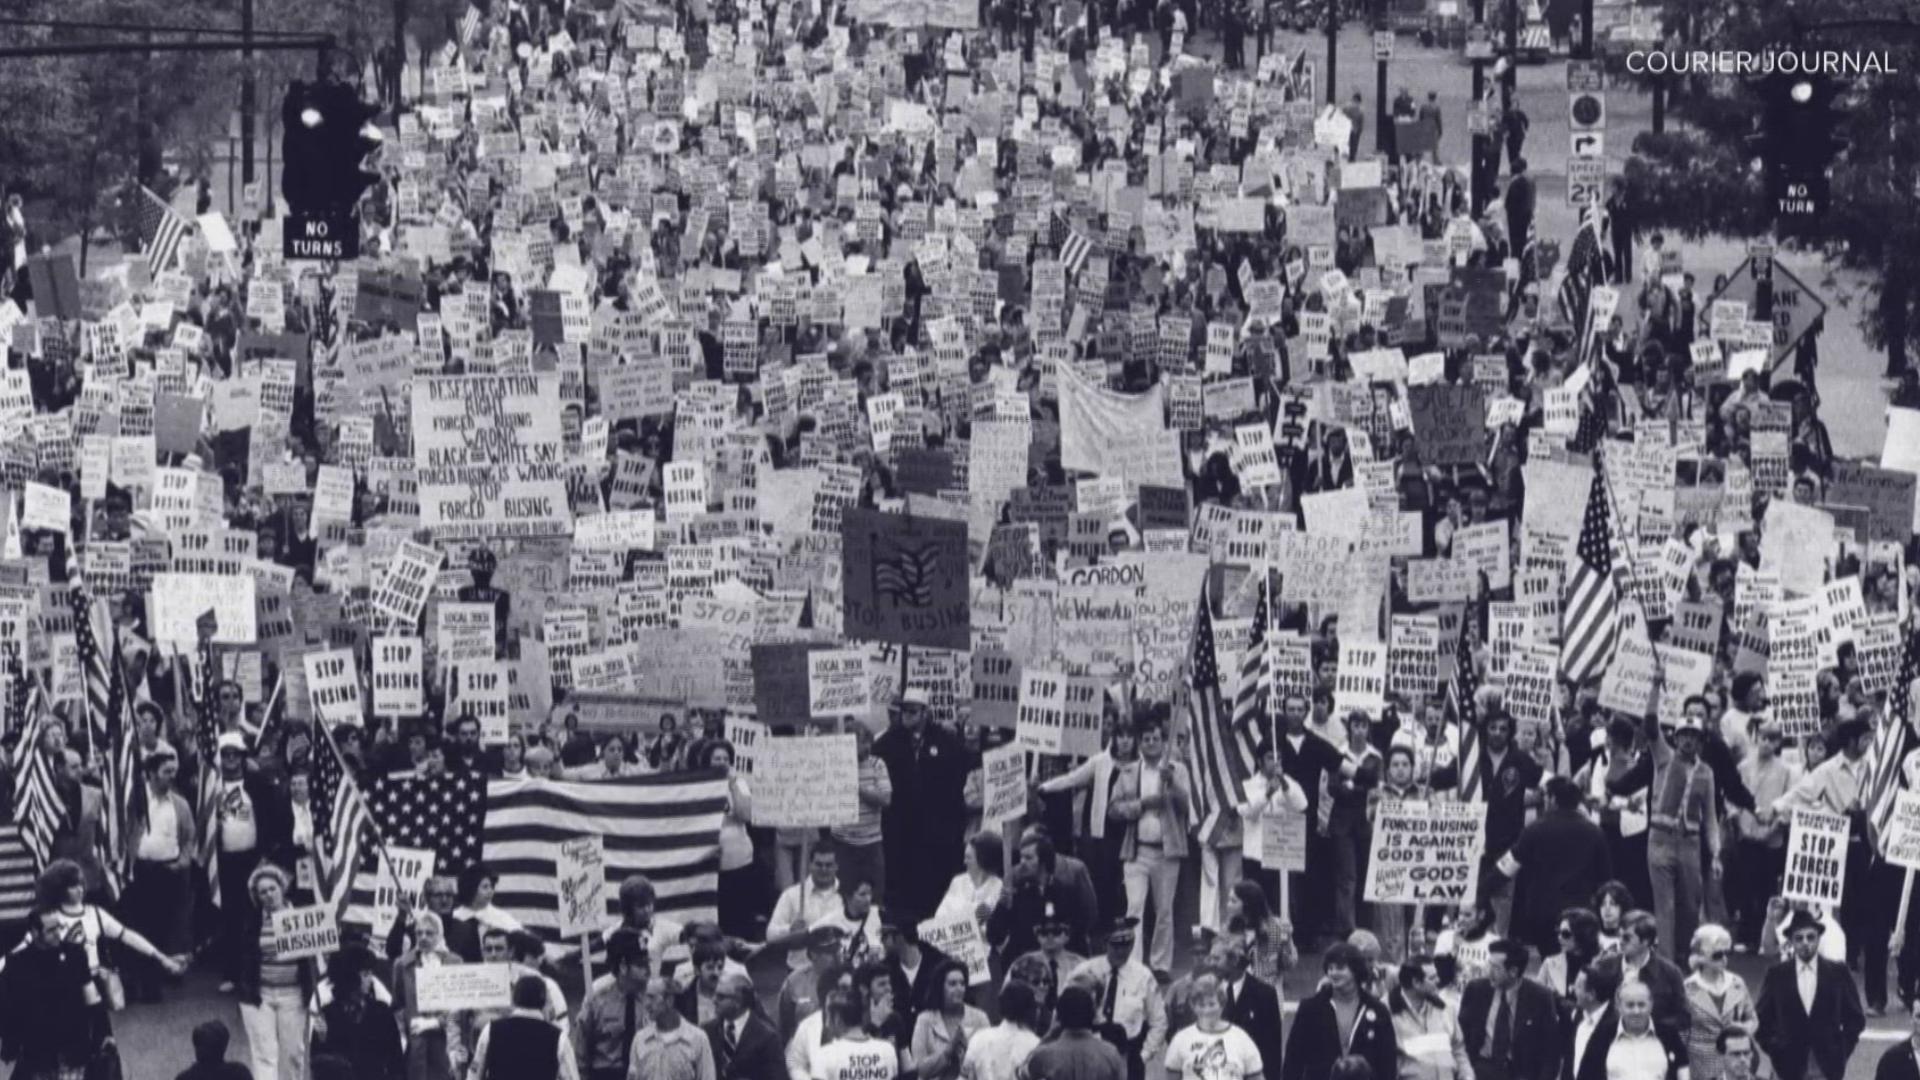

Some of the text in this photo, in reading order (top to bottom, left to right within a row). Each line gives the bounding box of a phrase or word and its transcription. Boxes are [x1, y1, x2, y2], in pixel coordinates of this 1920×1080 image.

[1571, 164, 1601, 172] SPEED
[1571, 184, 1600, 202] 25
[1787, 184, 1808, 197] NO
[1778, 200, 1815, 214] TURN
[305, 221, 329, 237] NO
[291, 239, 343, 256] TURNS
[428, 376, 539, 400] DESEGREGATION
[874, 398, 897, 414] STOP
[432, 411, 532, 431] FORCED BUSING
[461, 427, 519, 449] WRONG
[1242, 430, 1263, 446] STOP
[429, 441, 558, 468] BLACK WHITE SAY
[418, 462, 563, 487] FORCED BUSING IS WRONG
[622, 459, 647, 476] STOP
[670, 467, 696, 483] STOP
[163, 474, 189, 490] STOP
[613, 478, 646, 496] BUSING
[470, 481, 502, 501] STOP
[666, 489, 703, 505] BUSING
[154, 495, 192, 510] BUSING
[438, 496, 553, 521] FORCED BUSING
[731, 495, 757, 511] STOP
[811, 506, 842, 518] FORC
[165, 514, 190, 530] STOP
[1077, 518, 1101, 534] STOP
[1237, 518, 1263, 535] STOP
[181, 533, 209, 550] STOP
[223, 536, 250, 553] STOP
[1070, 542, 1108, 557] BUSING
[174, 557, 215, 573] BUSING
[398, 559, 428, 582] STOP
[671, 559, 696, 570] LOCAL
[1526, 557, 1567, 570] OPPOSE
[669, 575, 714, 588] AGAINST
[1071, 561, 1145, 587] GORDON
[386, 573, 425, 601] FORCED
[1523, 577, 1549, 595] STOP
[377, 588, 420, 619] BUSING
[1826, 584, 1852, 606] STOP
[621, 611, 668, 629] OPPOSE
[1683, 610, 1713, 631] STOP
[1832, 606, 1864, 631] USING
[1498, 621, 1525, 639] STOP
[548, 642, 589, 659] PPOSE
[1771, 636, 1814, 653] OPPOSE
[382, 645, 412, 662] STOP
[1346, 649, 1377, 667] STOP
[1391, 649, 1438, 662] OPPOSE
[314, 658, 346, 679] STOP
[982, 657, 1013, 676] STOP
[1391, 663, 1438, 677] FORCED
[375, 672, 420, 690] BUSING
[467, 673, 499, 691] STOP
[1274, 668, 1312, 683] PPOSE
[1506, 673, 1552, 693] OPPOSE
[973, 683, 1019, 703] BUSING
[1030, 679, 1058, 699] STOP
[1275, 684, 1313, 698] ORCED
[1338, 674, 1382, 695] BUSING
[1392, 678, 1438, 691] BUSING
[311, 684, 357, 706] BUSING
[1065, 685, 1095, 703] STOP
[1504, 690, 1552, 707] FORCED
[1771, 691, 1818, 707] OPPOSE
[461, 700, 507, 718] BUSING
[1019, 704, 1062, 729] BUSING
[1773, 706, 1819, 722] FORCED
[732, 726, 756, 746] STOP
[1784, 720, 1820, 736] USING
[1381, 817, 1479, 833] FORCED BUSING
[1386, 834, 1476, 848] IS AGAINST
[1801, 832, 1836, 857] STOP
[1377, 849, 1468, 863] GODS WILL
[1409, 865, 1470, 882] GODS
[1792, 852, 1840, 880] FORCED
[1413, 885, 1468, 899] LAW
[1786, 873, 1840, 900] BUSING
[281, 909, 327, 934] STOP
[275, 927, 339, 954] BUSSING
[848, 1052, 881, 1068] STOP
[839, 1066, 889, 1079] BUSING
